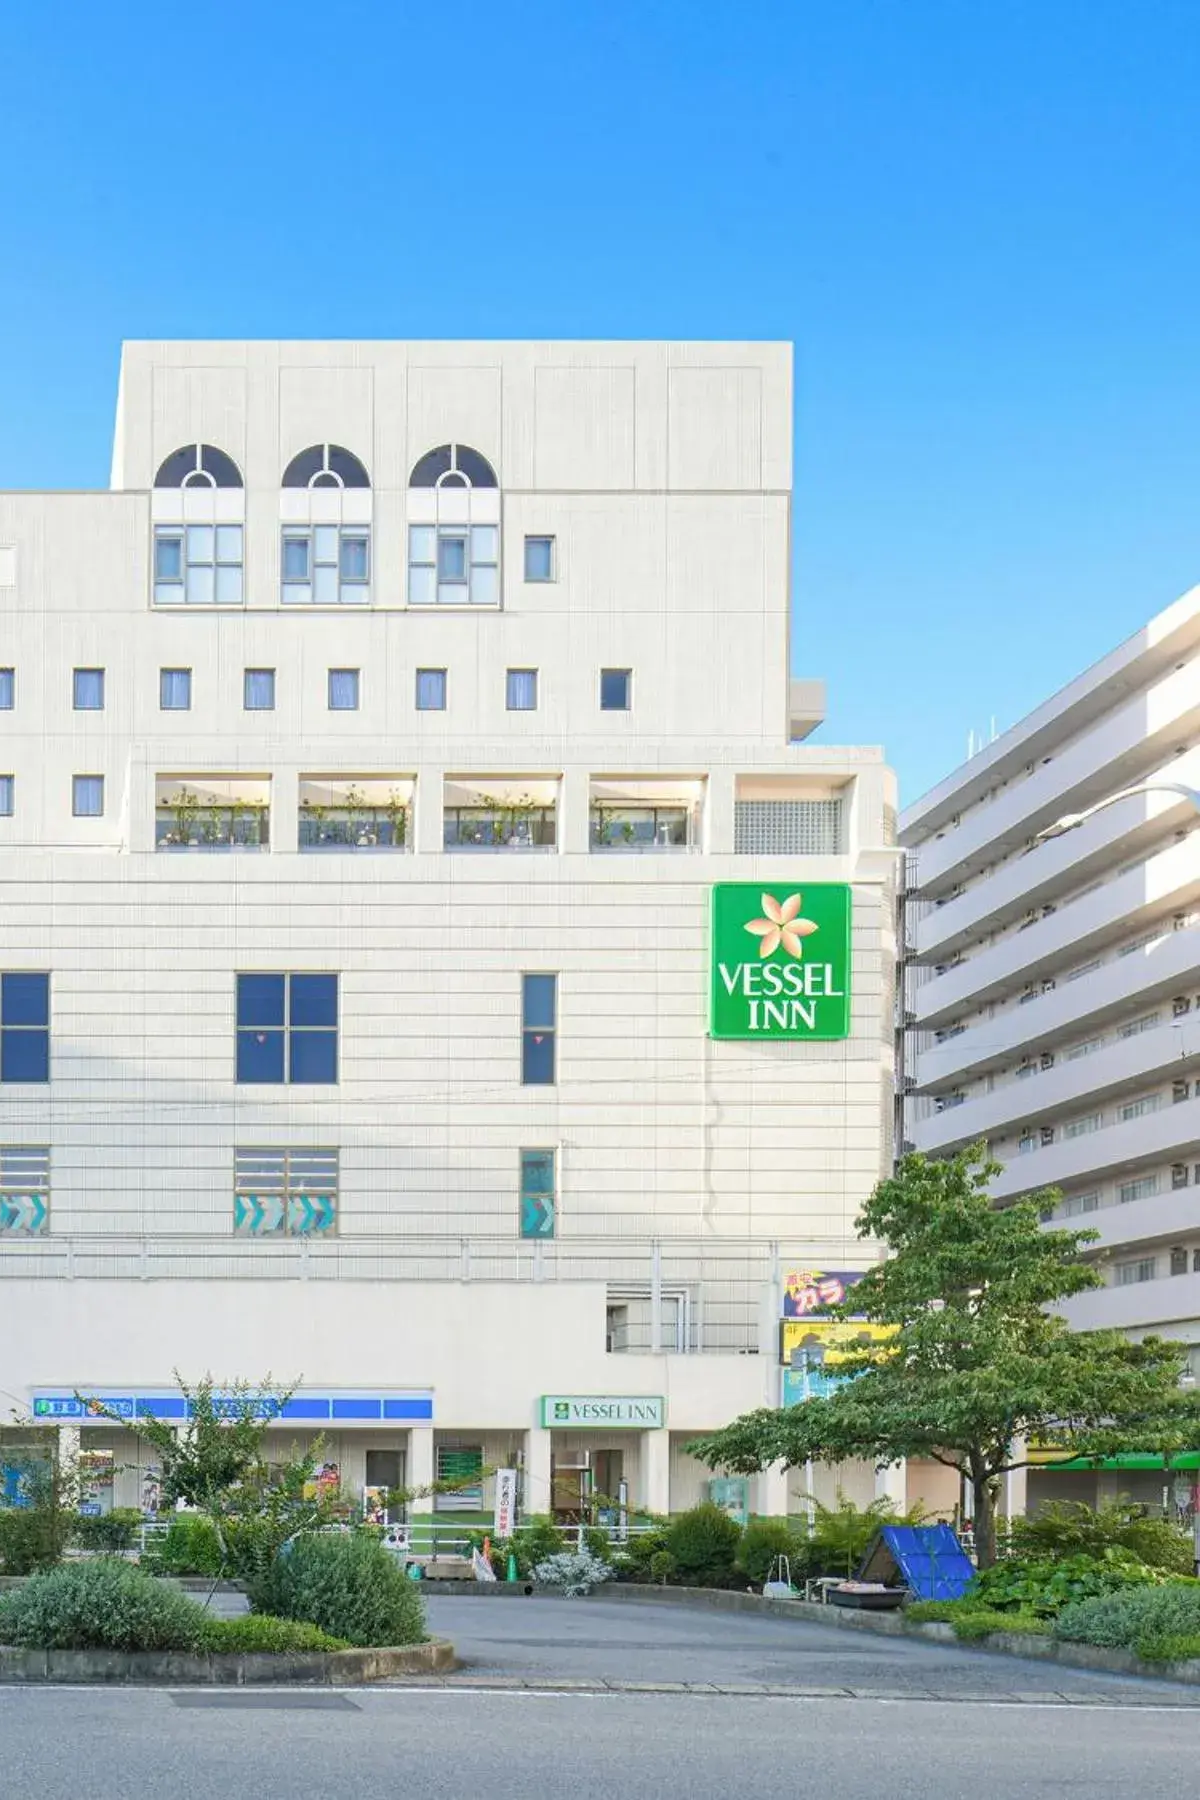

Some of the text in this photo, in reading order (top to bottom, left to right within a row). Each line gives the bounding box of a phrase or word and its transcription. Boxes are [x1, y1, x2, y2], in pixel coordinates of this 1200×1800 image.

[718, 963, 844, 996] VESSEL
[748, 1000, 816, 1030] INN
[573, 1404, 657, 1419] VESSEL INN
